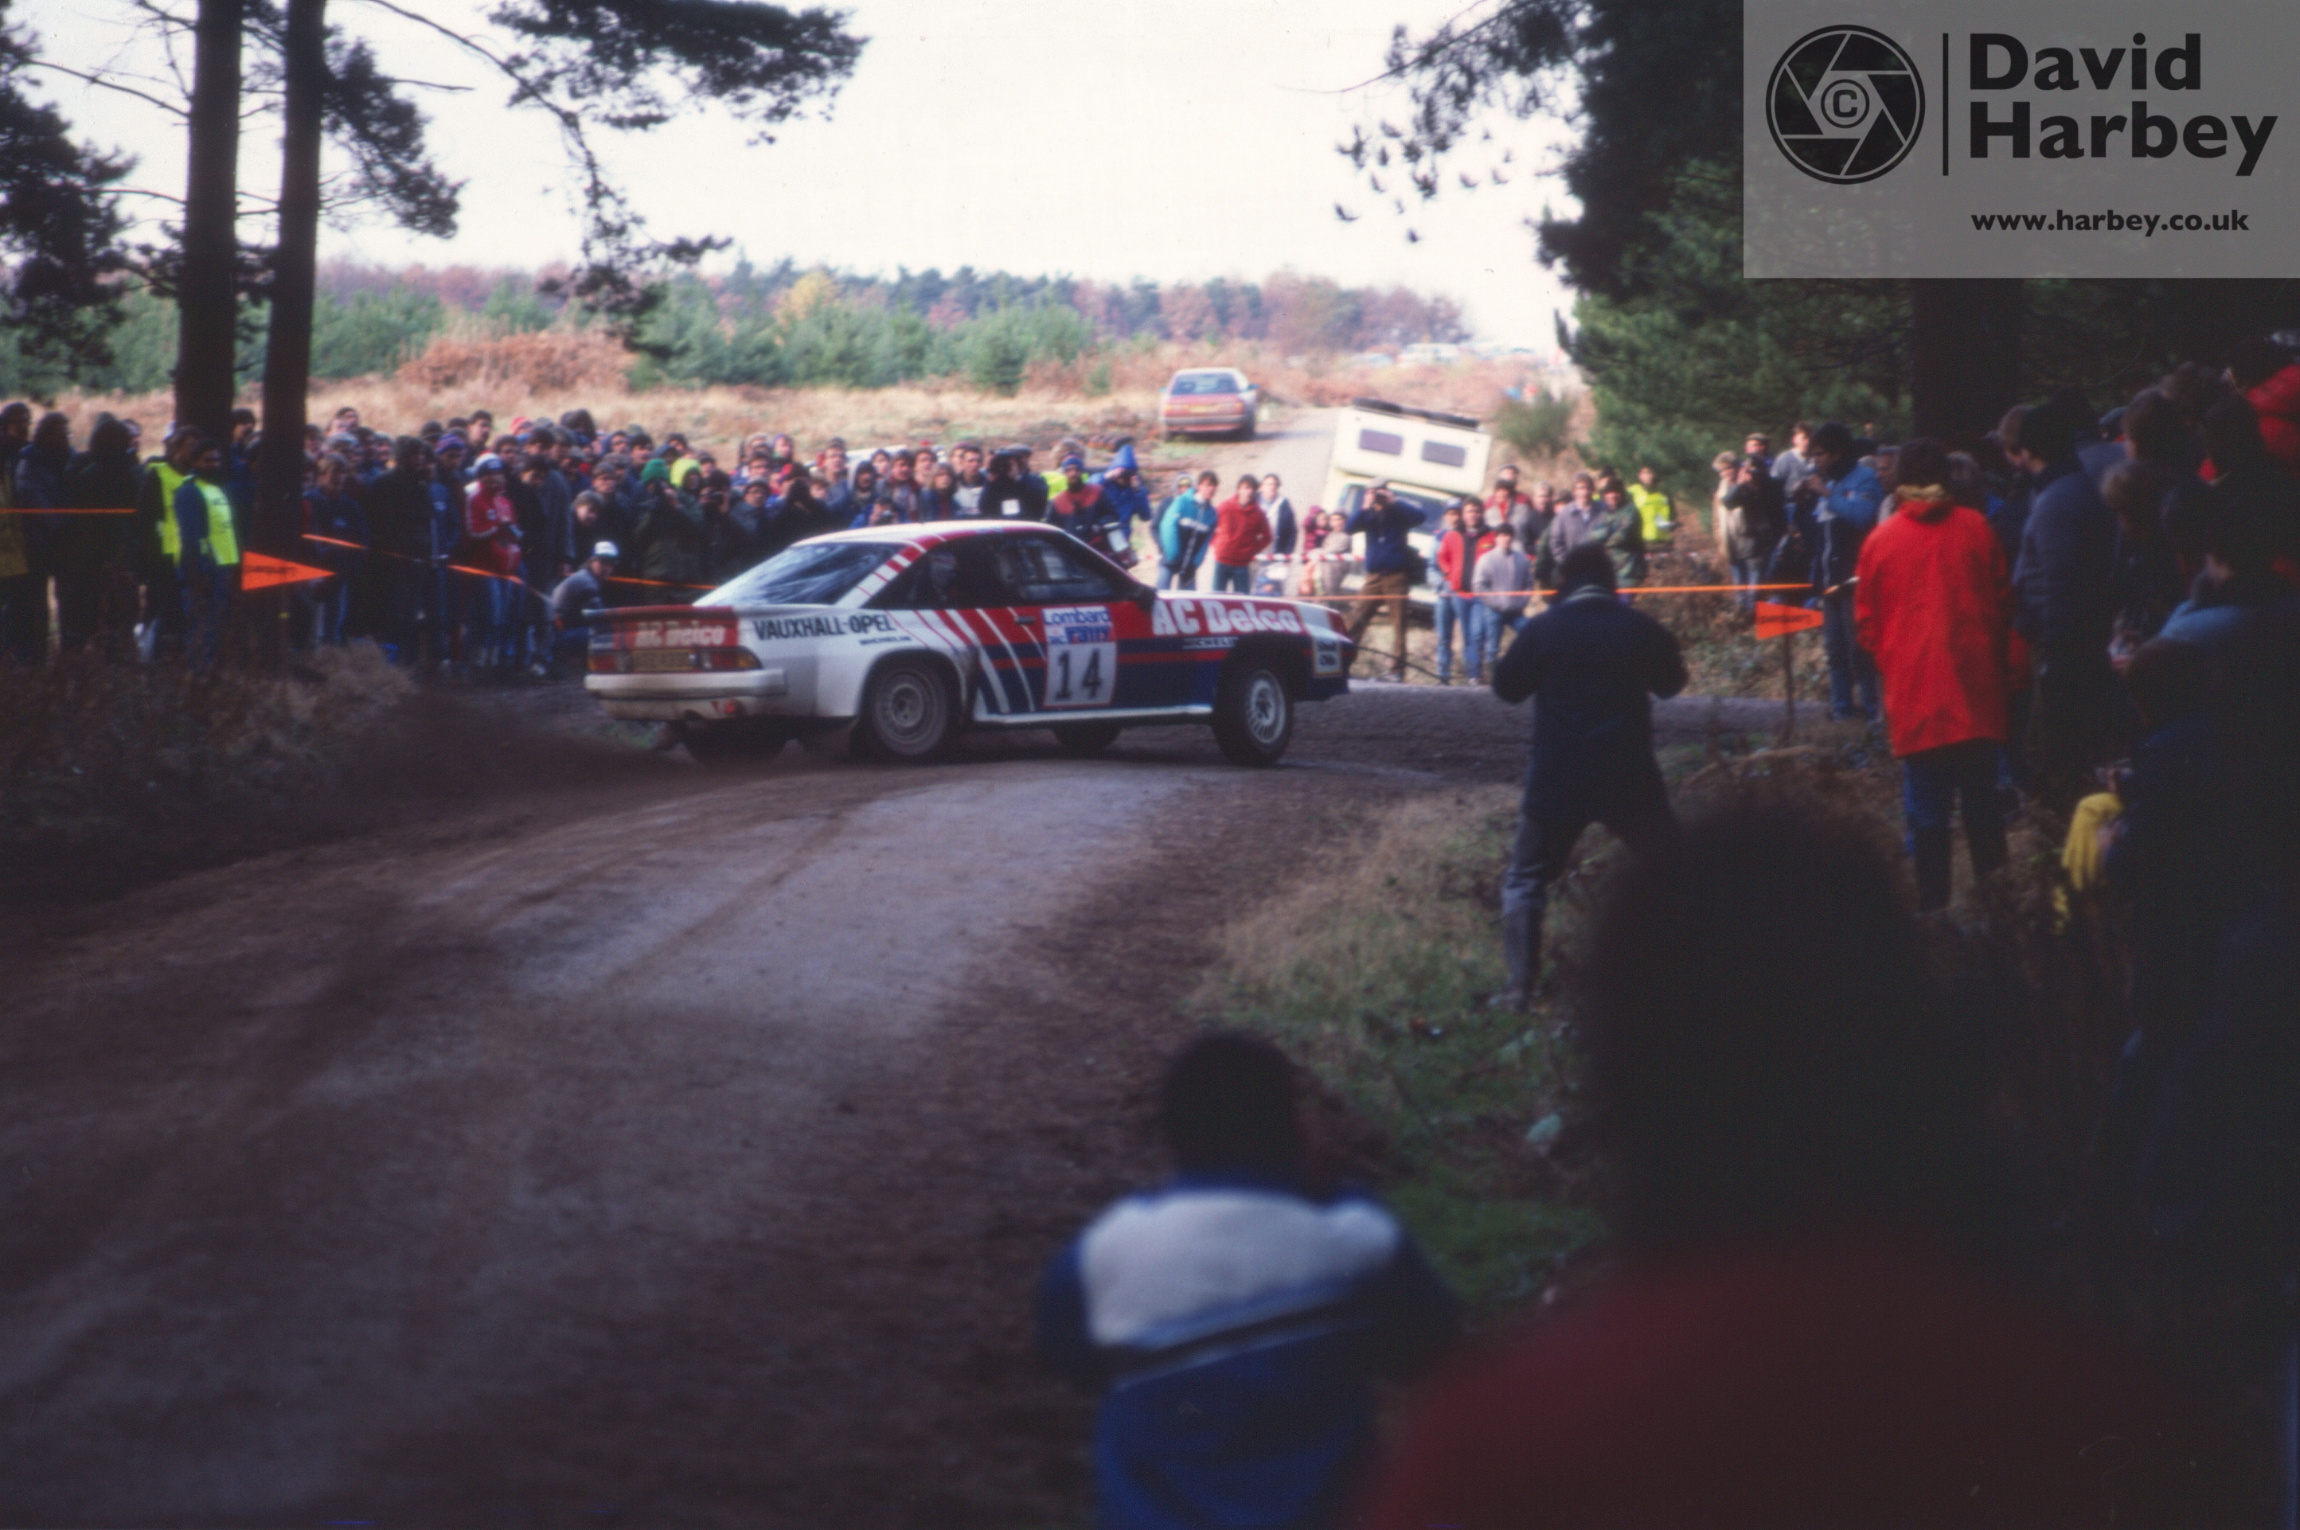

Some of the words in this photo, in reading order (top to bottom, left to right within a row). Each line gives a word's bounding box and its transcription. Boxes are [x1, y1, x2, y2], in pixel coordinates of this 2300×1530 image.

[753, 614, 896, 641] VAUXHALL-OPEL
[1043, 606, 1111, 625] Lombard
[1152, 599, 1200, 635] AC
[1201, 599, 1301, 633] Delco
[1055, 648, 1103, 701] 14
